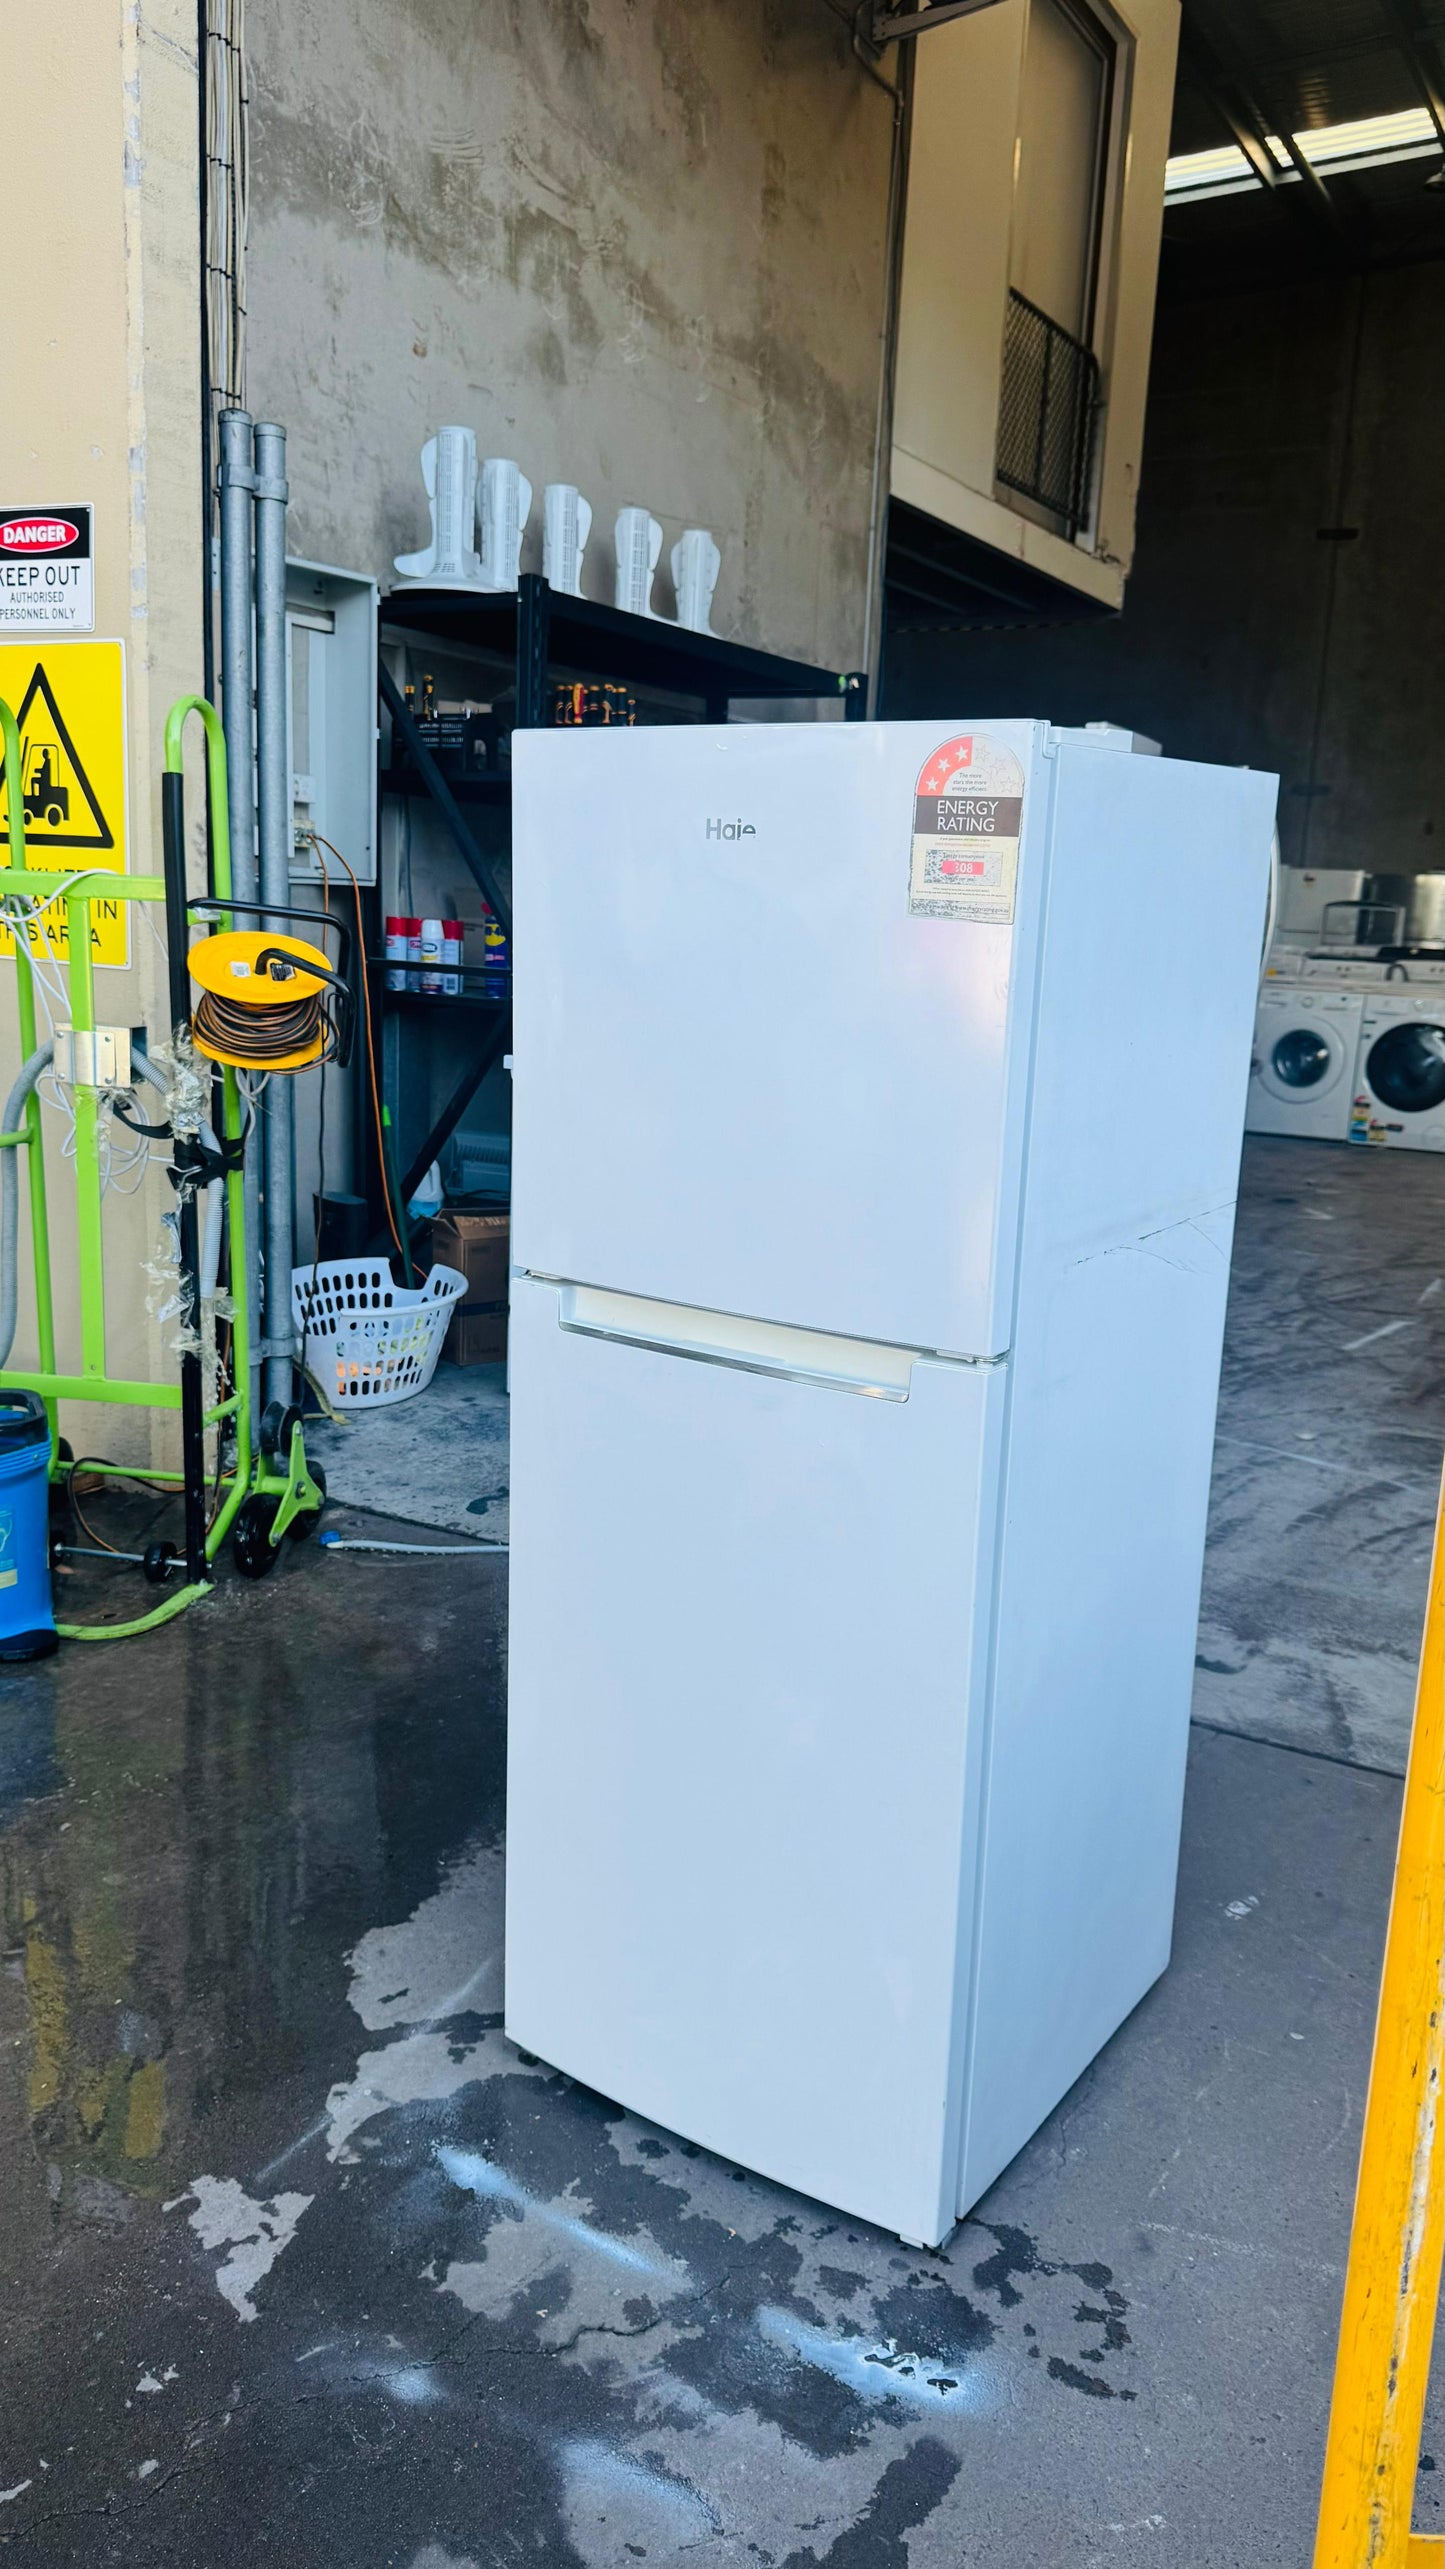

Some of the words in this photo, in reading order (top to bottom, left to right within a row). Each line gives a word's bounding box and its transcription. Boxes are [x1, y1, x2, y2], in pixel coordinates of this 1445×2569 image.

[3, 525, 66, 544] DANGER
[45, 565, 80, 585] OUT
[10, 591, 64, 603] AUTHORISED
[0, 607, 49, 620] PERSONNEL
[52, 607, 76, 619] ONLY
[937, 800, 999, 815] ENERGY
[937, 817, 995, 832] RATING
[97, 899, 117, 919] IN
[47, 924, 101, 947] ARA
